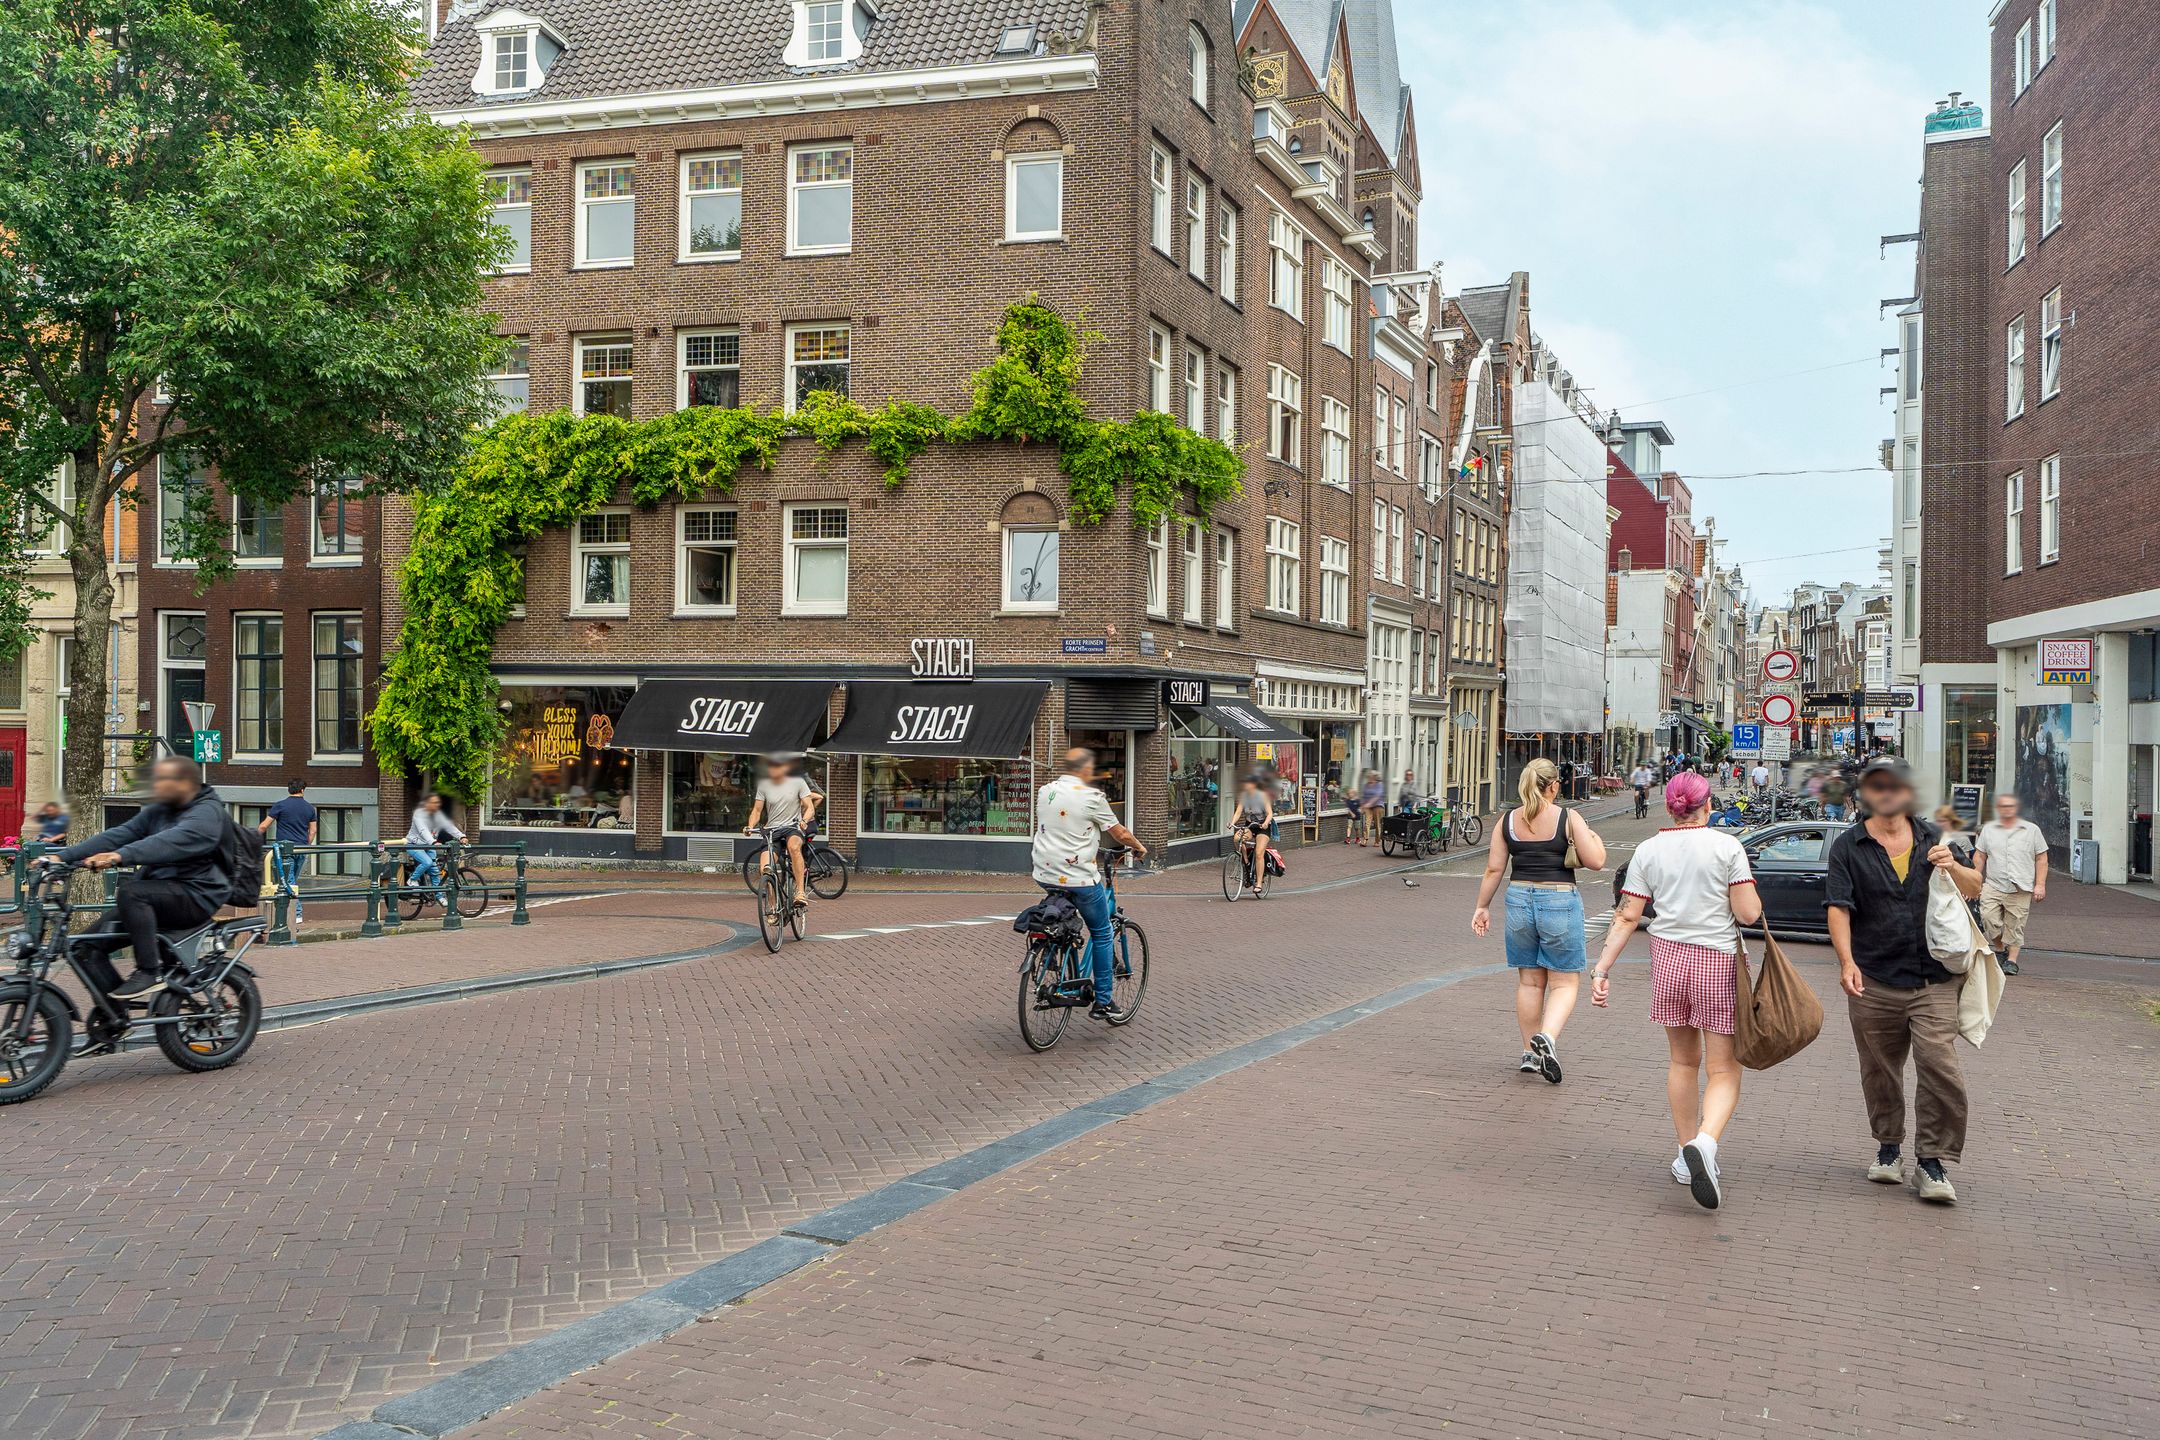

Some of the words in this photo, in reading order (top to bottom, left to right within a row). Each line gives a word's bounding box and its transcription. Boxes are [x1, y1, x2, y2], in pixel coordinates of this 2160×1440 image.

[2047, 643, 2086, 651] SNACKS
[911, 638, 974, 675] STACH
[2047, 658, 2086, 666] DRINKS
[2047, 672, 2086, 682] ATM
[1170, 681, 1203, 702] STACH
[543, 707, 577, 723] BLESS
[681, 697, 765, 733] STACH
[890, 705, 974, 741] STACH
[547, 723, 575, 739] YOUR
[1738, 727, 1755, 739] 15
[542, 738, 582, 755] BLOOM!
